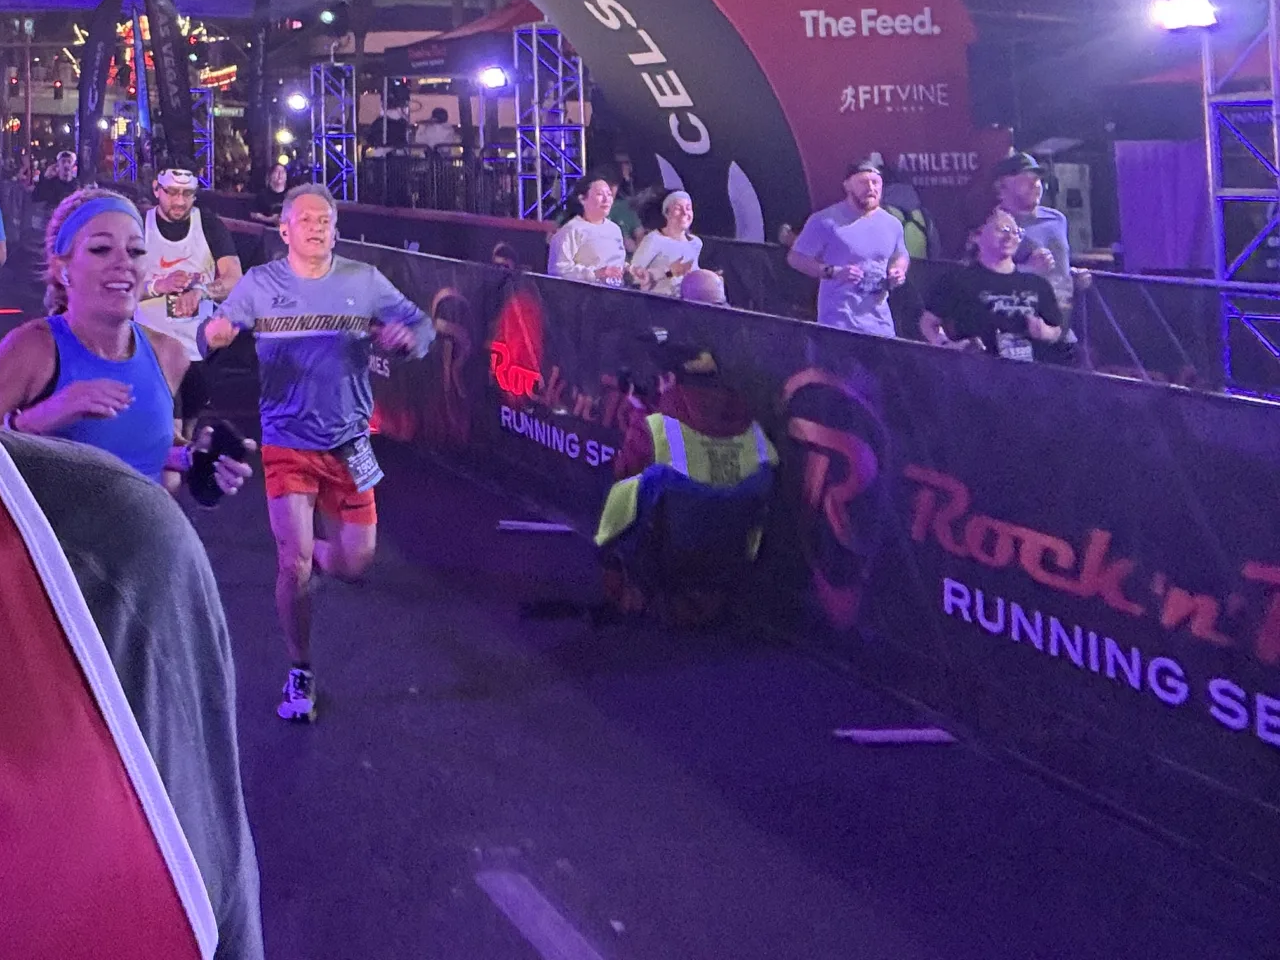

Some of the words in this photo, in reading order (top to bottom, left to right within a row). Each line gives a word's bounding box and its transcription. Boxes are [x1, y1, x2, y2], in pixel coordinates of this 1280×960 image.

[800, 9, 857, 38] The
[859, 83, 950, 110] FITVINE
[898, 151, 980, 172] ATHLETIC
[500, 405, 581, 460] RUNNING
[903, 463, 1147, 616] Rock
[942, 577, 1190, 706] RUNNING
